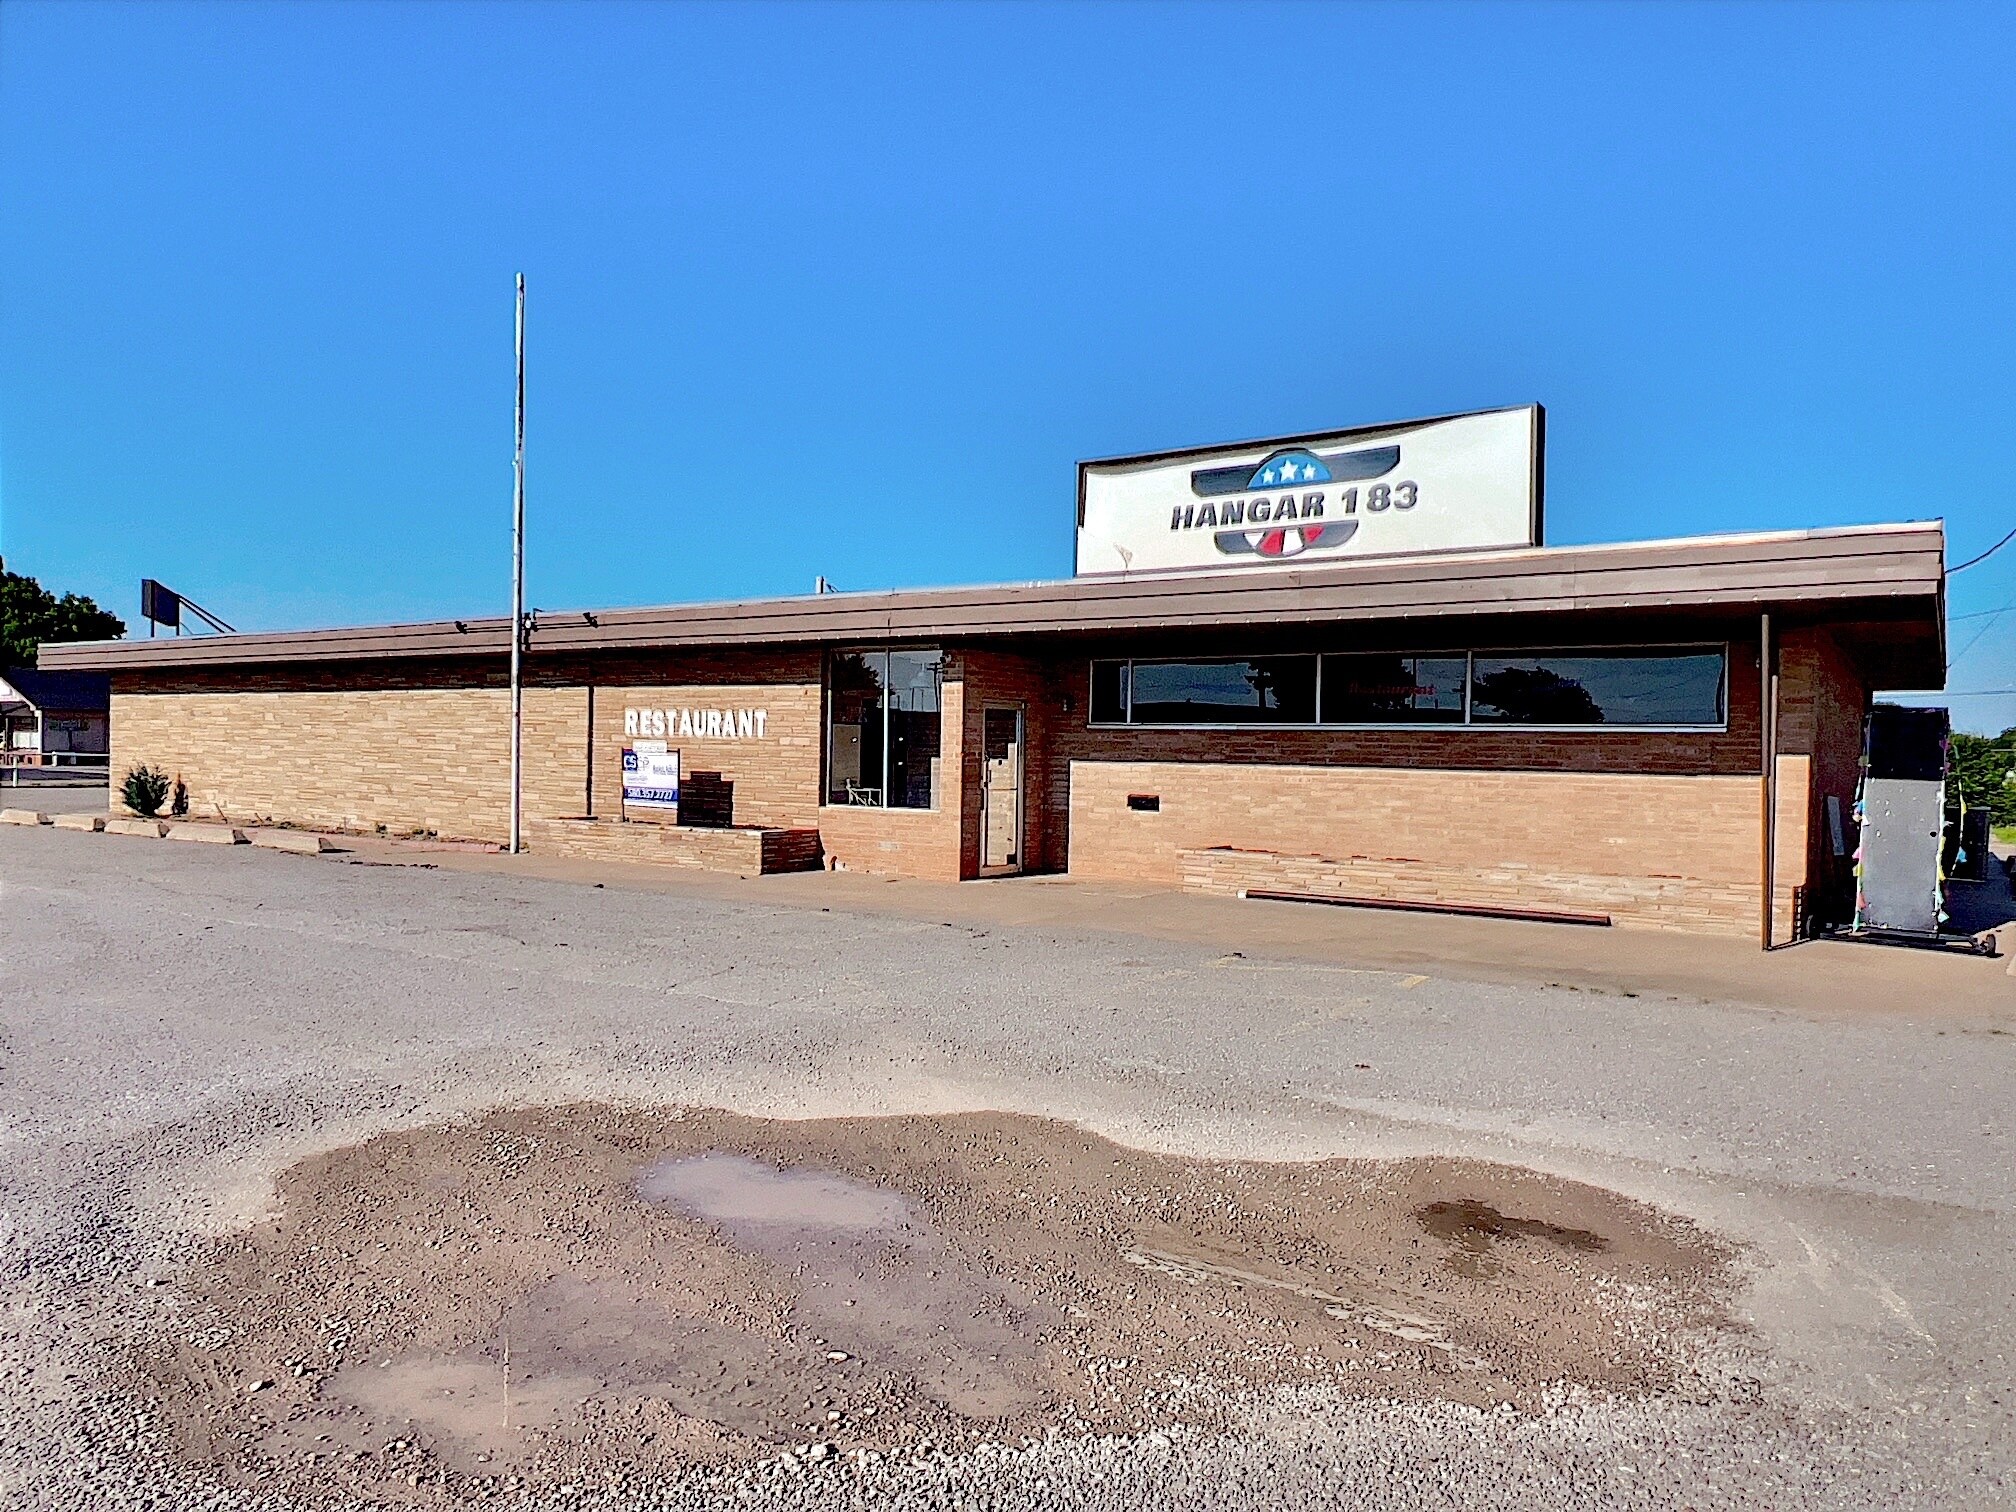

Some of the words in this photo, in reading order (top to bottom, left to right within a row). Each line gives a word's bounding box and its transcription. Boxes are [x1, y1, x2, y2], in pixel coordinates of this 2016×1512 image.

[1170, 491, 1325, 530] HANGAR
[1341, 480, 1418, 514] 183
[624, 707, 769, 738] RESTAURANT
